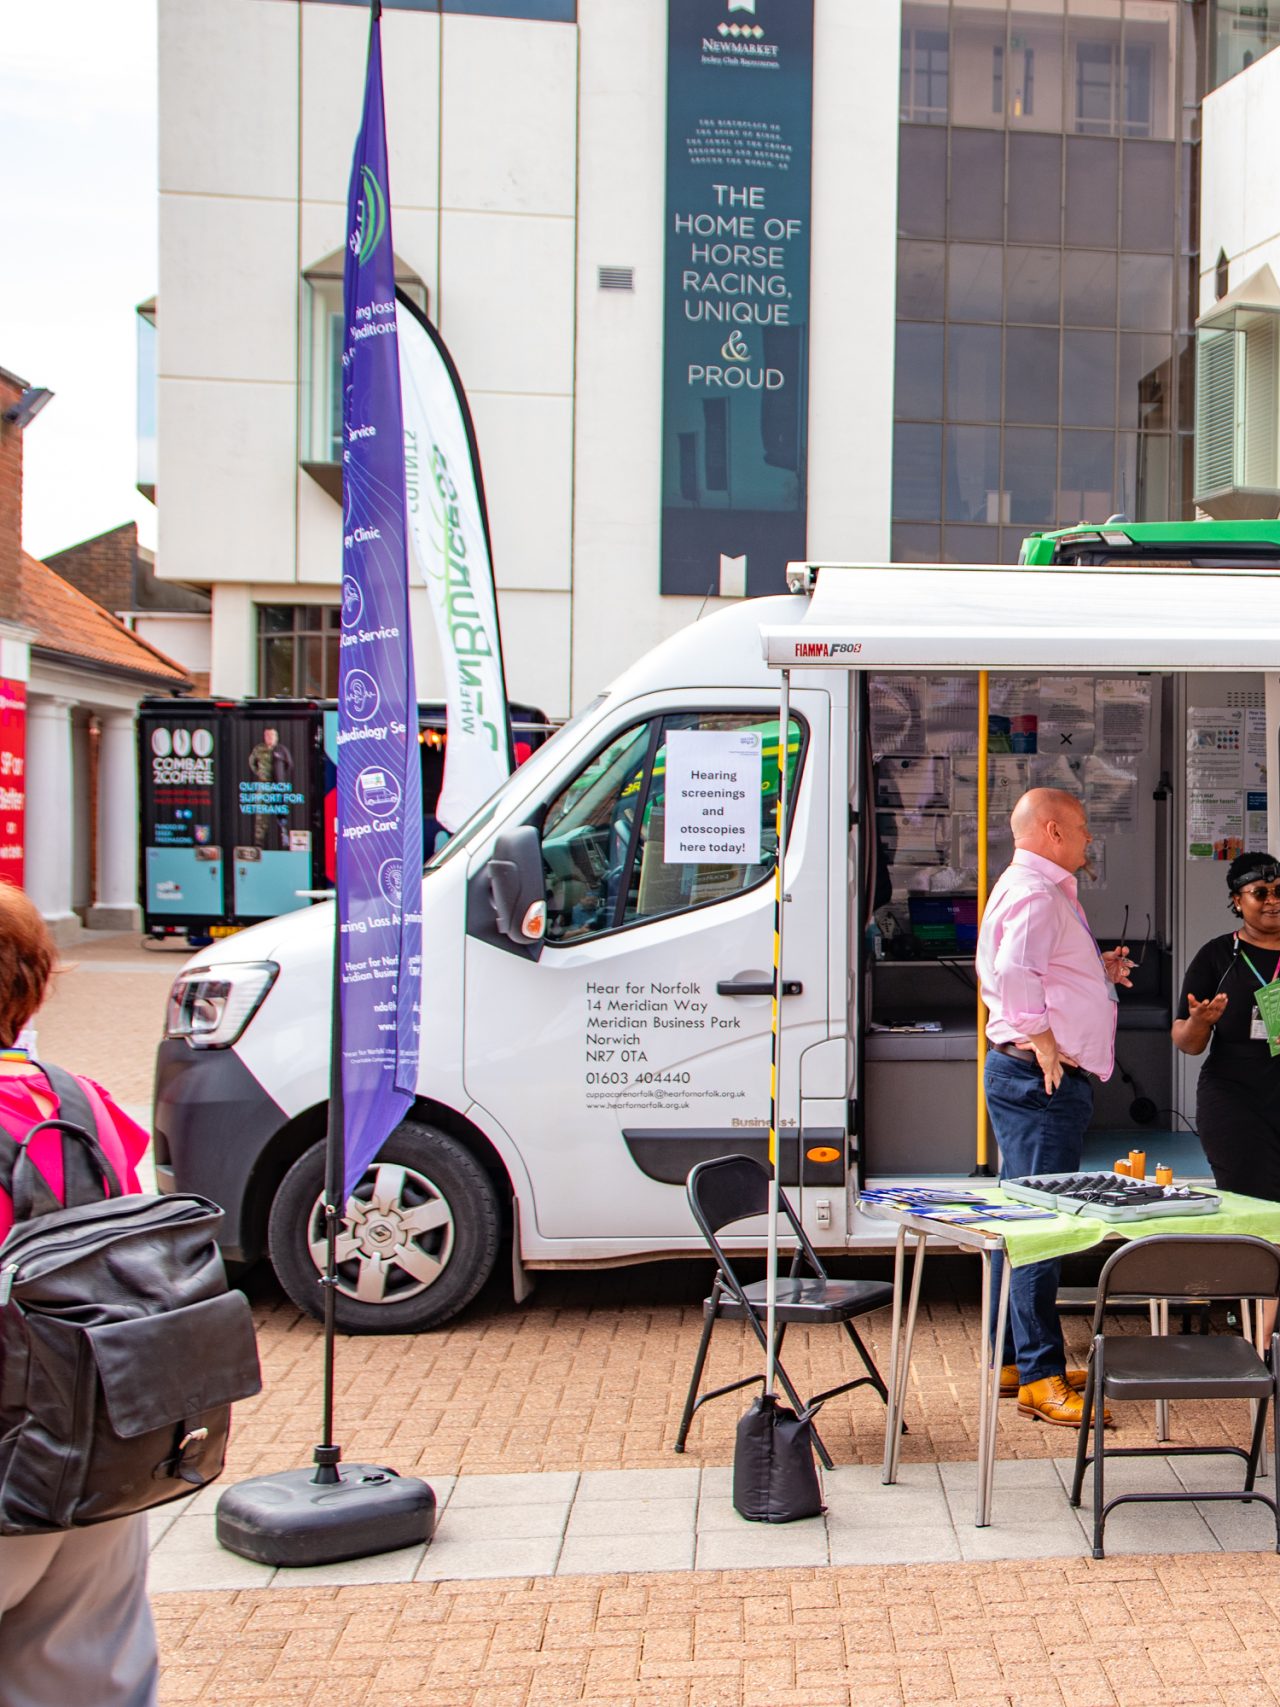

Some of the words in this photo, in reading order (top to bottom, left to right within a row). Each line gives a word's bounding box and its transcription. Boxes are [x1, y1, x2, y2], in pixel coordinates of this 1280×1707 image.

[702, 38, 779, 55] NEWMARKET
[723, 56, 739, 65] Club
[712, 184, 766, 210] THE
[675, 212, 756, 240] HOME
[763, 218, 802, 241] OF
[691, 242, 785, 269] HORSE
[683, 270, 793, 299] RACING,
[371, 301, 395, 315] loss
[685, 299, 790, 326] UNIQUE
[721, 330, 752, 362] &
[688, 365, 785, 390] PROUD
[354, 526, 381, 542] Clinic
[358, 626, 399, 642] Service
[795, 643, 829, 657] FIAMMA
[152, 757, 214, 771] COMBAT
[152, 770, 215, 785] 2COFFEE
[691, 770, 737, 782] Hearing
[239, 782, 293, 793] OUTREACH
[239, 793, 283, 804] SUPPORT
[283, 793, 305, 804] FOR
[682, 789, 746, 800] screenings
[702, 806, 725, 816] and
[680, 825, 746, 836] otoscopies
[680, 842, 706, 852] here
[709, 842, 746, 854] today!
[368, 917, 391, 928] Loss
[345, 962, 367, 972] Hear
[368, 957, 381, 967] for
[586, 982, 620, 994] Hear
[625, 982, 645, 994] for
[650, 982, 701, 994] Norfolk
[586, 1000, 602, 1011] 14
[607, 1000, 668, 1011] Meridian
[674, 1000, 708, 1014] Way
[586, 1017, 647, 1028] Meridian
[653, 1017, 705, 1028] Business
[710, 1017, 741, 1028] Park
[586, 1034, 641, 1045] Norwich
[586, 1050, 615, 1062] NR7
[585, 1072, 629, 1084] 01603
[634, 1072, 691, 1084] 404440
[585, 1089, 746, 1100] cuppacarenorfolk@hearfornorfolk.org.uk
[586, 1101, 690, 1110] www.hearfornorfolk.org.uk
[731, 1117, 797, 1127] Busines+
